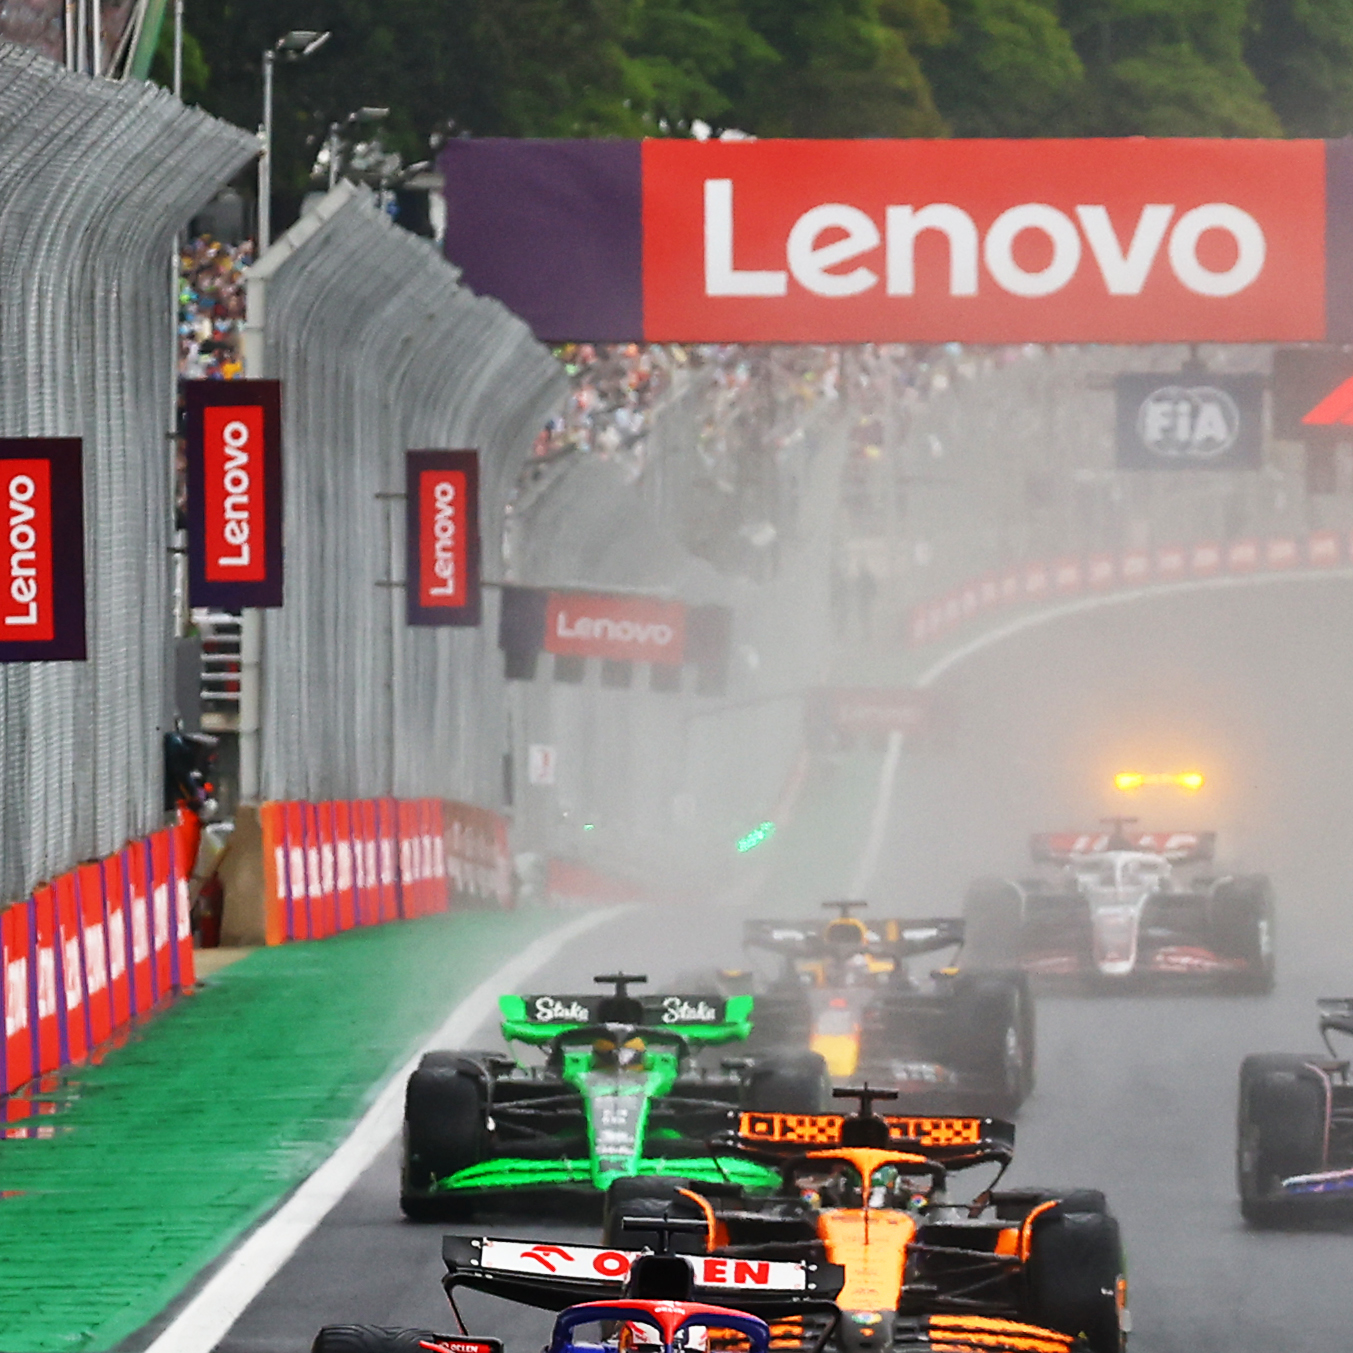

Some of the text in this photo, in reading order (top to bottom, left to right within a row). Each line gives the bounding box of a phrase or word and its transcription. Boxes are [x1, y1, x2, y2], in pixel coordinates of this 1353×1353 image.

[704, 178, 1267, 298] Lenovo
[218, 420, 251, 568] Lenovo
[4, 473, 37, 626] Lenovo
[429, 481, 455, 598] Lenovo
[556, 607, 675, 648] Lenovo
[535, 996, 590, 1022] Stake
[662, 996, 716, 1023] Stake
[592, 1250, 770, 1286] OEN
